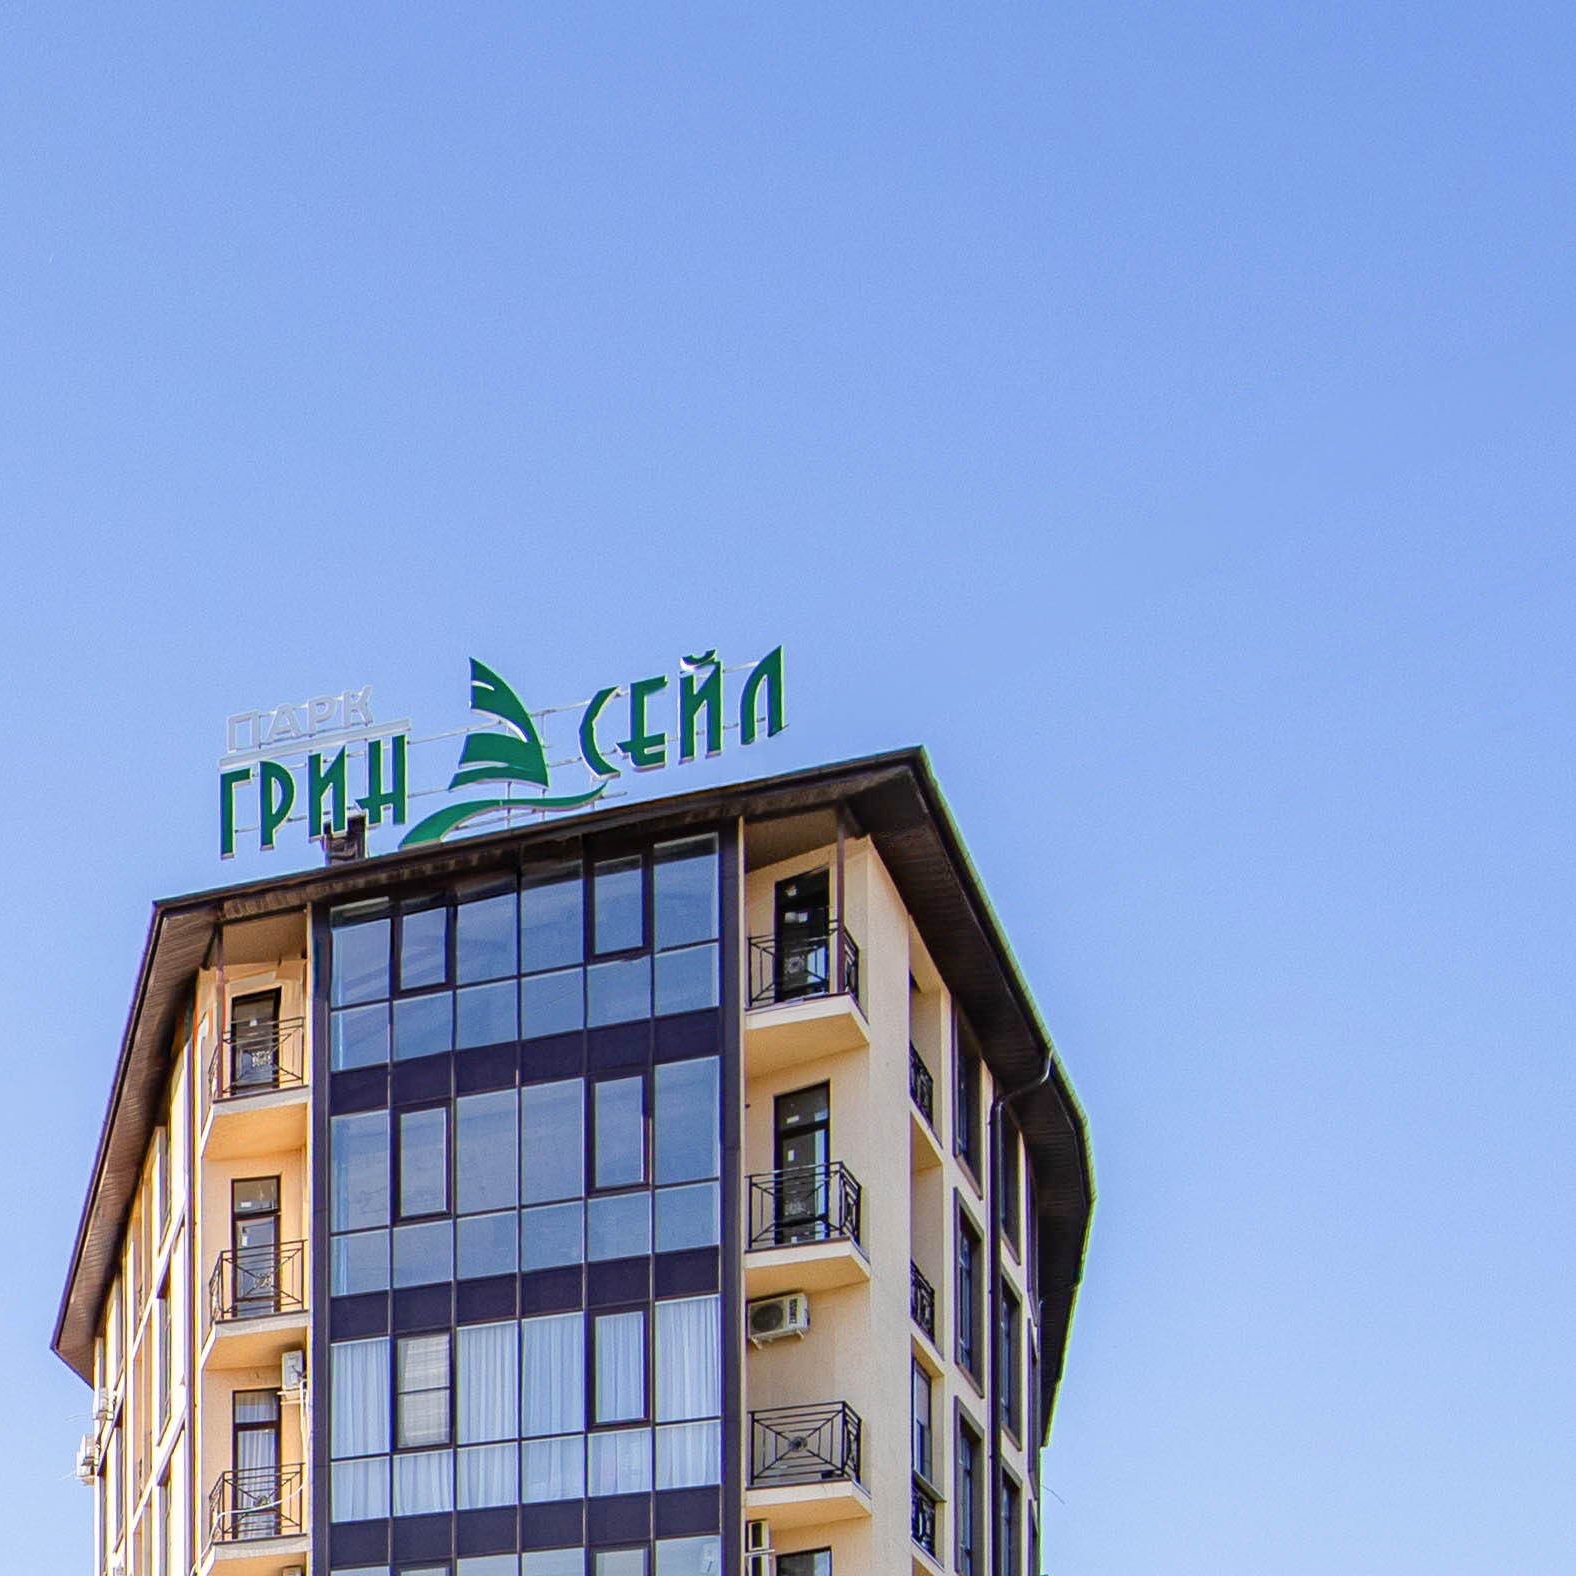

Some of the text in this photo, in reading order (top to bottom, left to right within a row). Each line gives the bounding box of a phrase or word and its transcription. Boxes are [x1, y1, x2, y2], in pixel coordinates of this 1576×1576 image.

[220, 645, 787, 859] ГРИН СЕЙЛ
[227, 685, 372, 752] ПАРК
